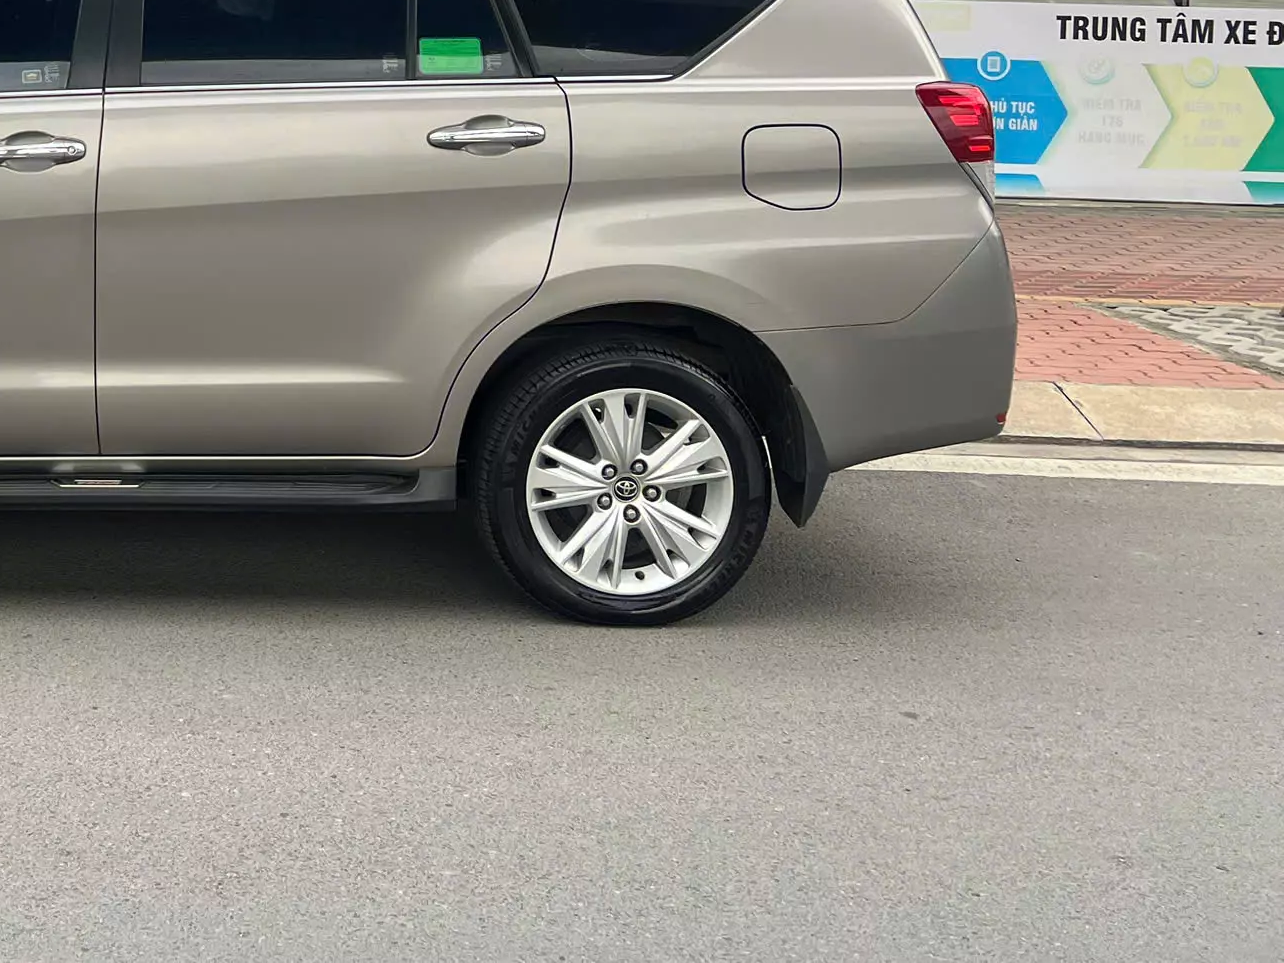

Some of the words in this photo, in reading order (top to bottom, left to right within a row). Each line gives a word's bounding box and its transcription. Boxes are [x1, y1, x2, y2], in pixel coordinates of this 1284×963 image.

[1056, 15, 1146, 43] TRUNG
[1156, 12, 1214, 44] TÂM
[1223, 20, 1258, 45] XE
[1266, 21, 1284, 46] Đ
[989, 97, 1007, 113] HỦ
[1010, 100, 1035, 116] TỤC
